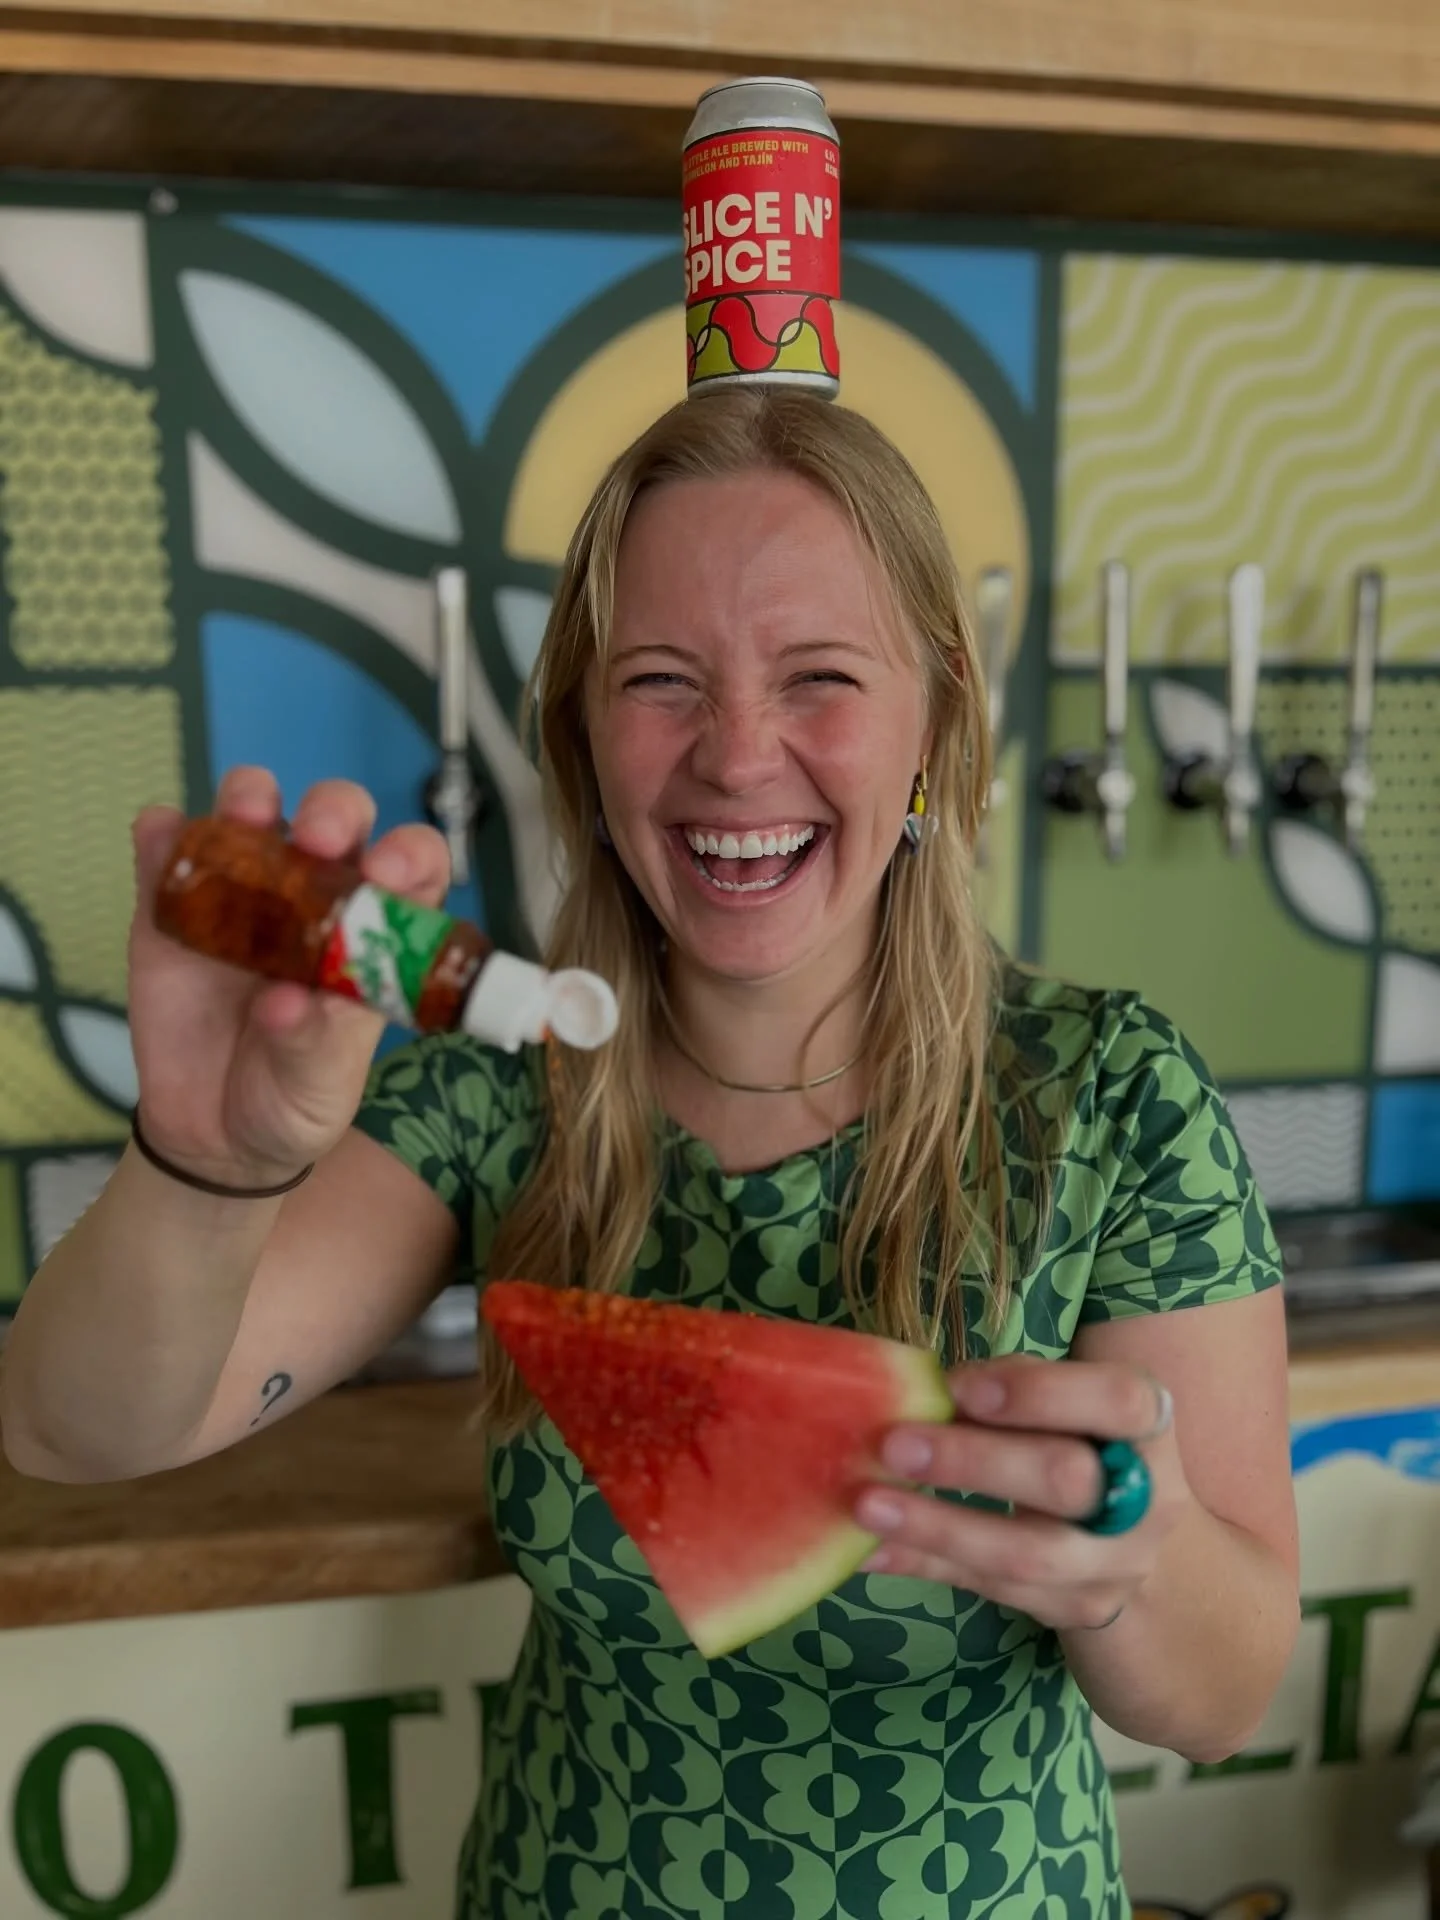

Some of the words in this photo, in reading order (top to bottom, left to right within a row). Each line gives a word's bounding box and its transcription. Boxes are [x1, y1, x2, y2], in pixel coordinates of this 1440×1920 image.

[711, 144, 729, 159] ALE
[731, 140, 779, 153] BREWED
[782, 140, 809, 153] WITH
[719, 156, 740, 170] AND
